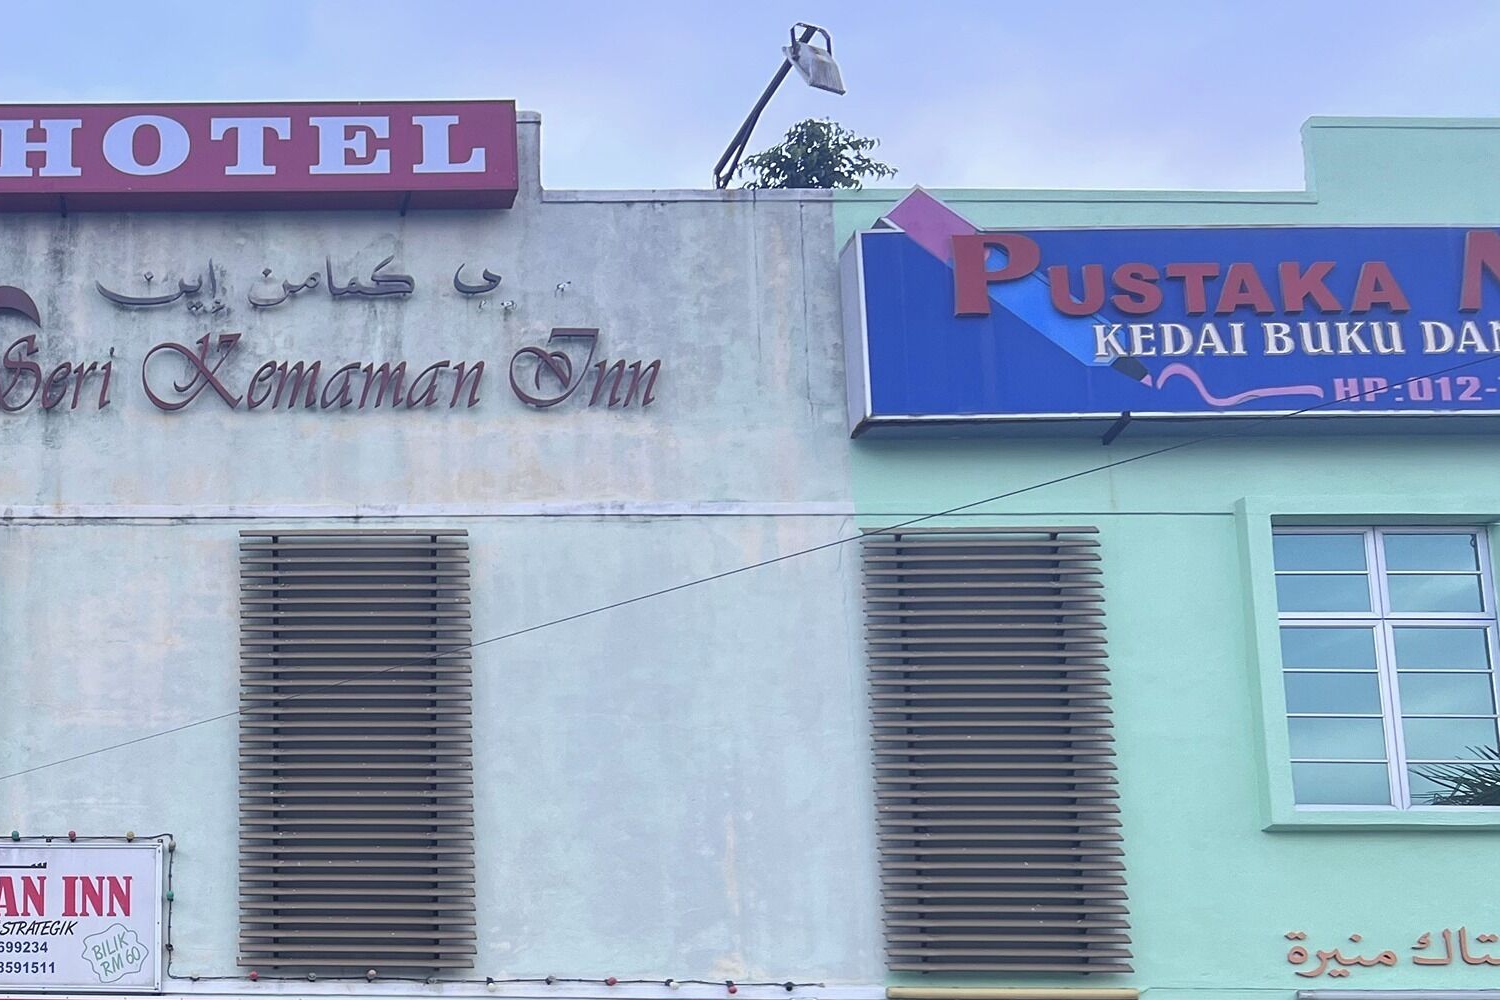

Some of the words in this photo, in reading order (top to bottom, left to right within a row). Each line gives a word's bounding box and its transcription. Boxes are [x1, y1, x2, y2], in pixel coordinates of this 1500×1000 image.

[952, 232, 1412, 317] PUSTAKA
[1093, 323, 1248, 359] KEDAI
[1263, 321, 1406, 356] BUKU
[141, 331, 486, 412] Kemaman
[508, 327, 662, 410] Inn
[61, 875, 133, 918] INN
[91, 931, 130, 961] BILIK
[100, 954, 124, 977] RM
[125, 946, 141, 965] 60
[1285, 931, 1398, 978] منيرة
